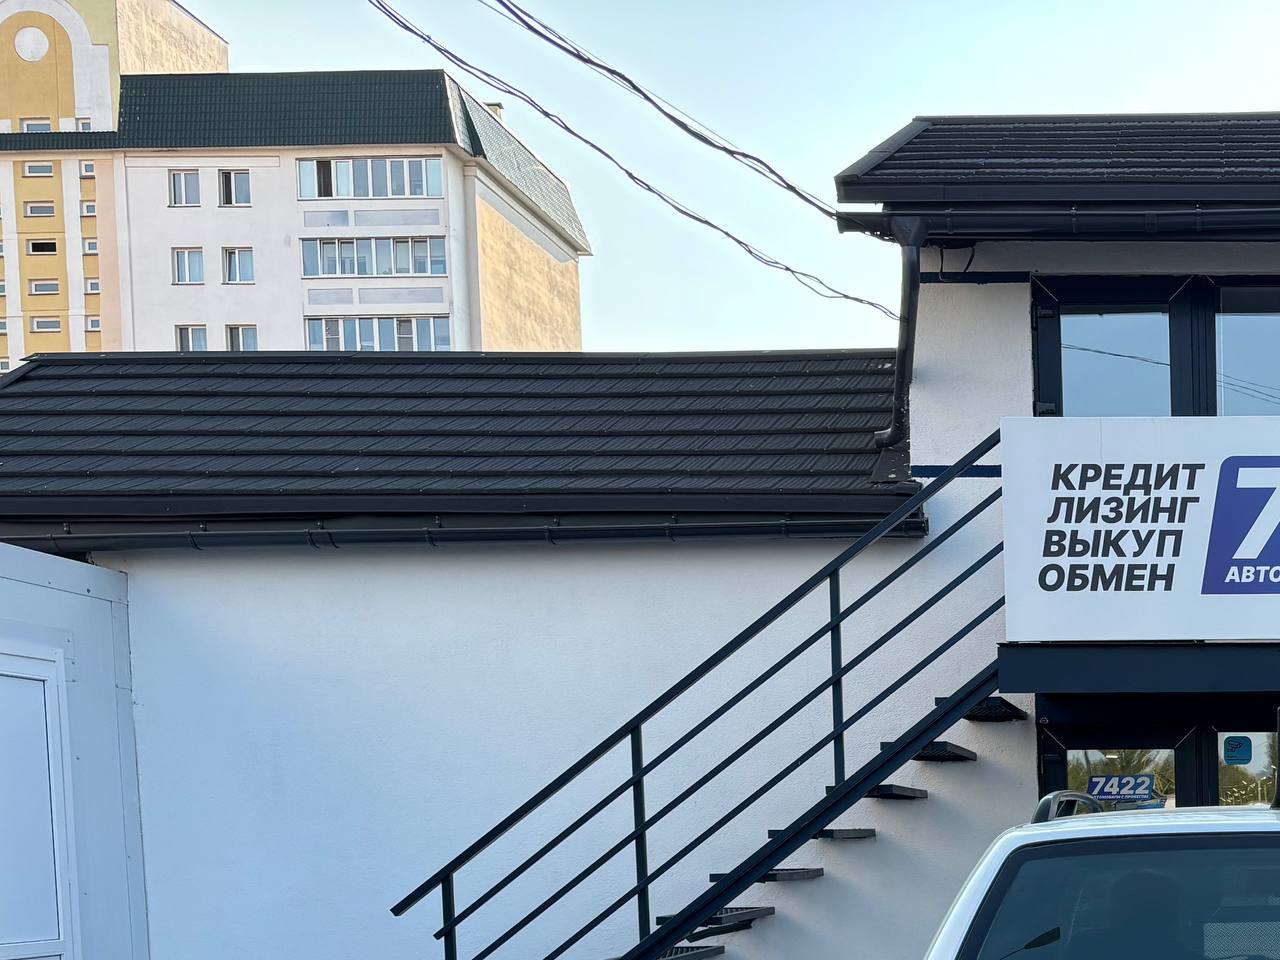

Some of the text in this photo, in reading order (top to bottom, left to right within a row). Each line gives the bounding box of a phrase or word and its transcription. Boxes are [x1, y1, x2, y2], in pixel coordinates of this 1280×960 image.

[1050, 463, 1206, 497] КРЕДИТ
[1046, 496, 1201, 524] ЛИЗИНГ
[1042, 529, 1184, 558] ВЫКУП
[1038, 563, 1176, 592] ОБМЕН
[1092, 776, 1151, 795] 7422
